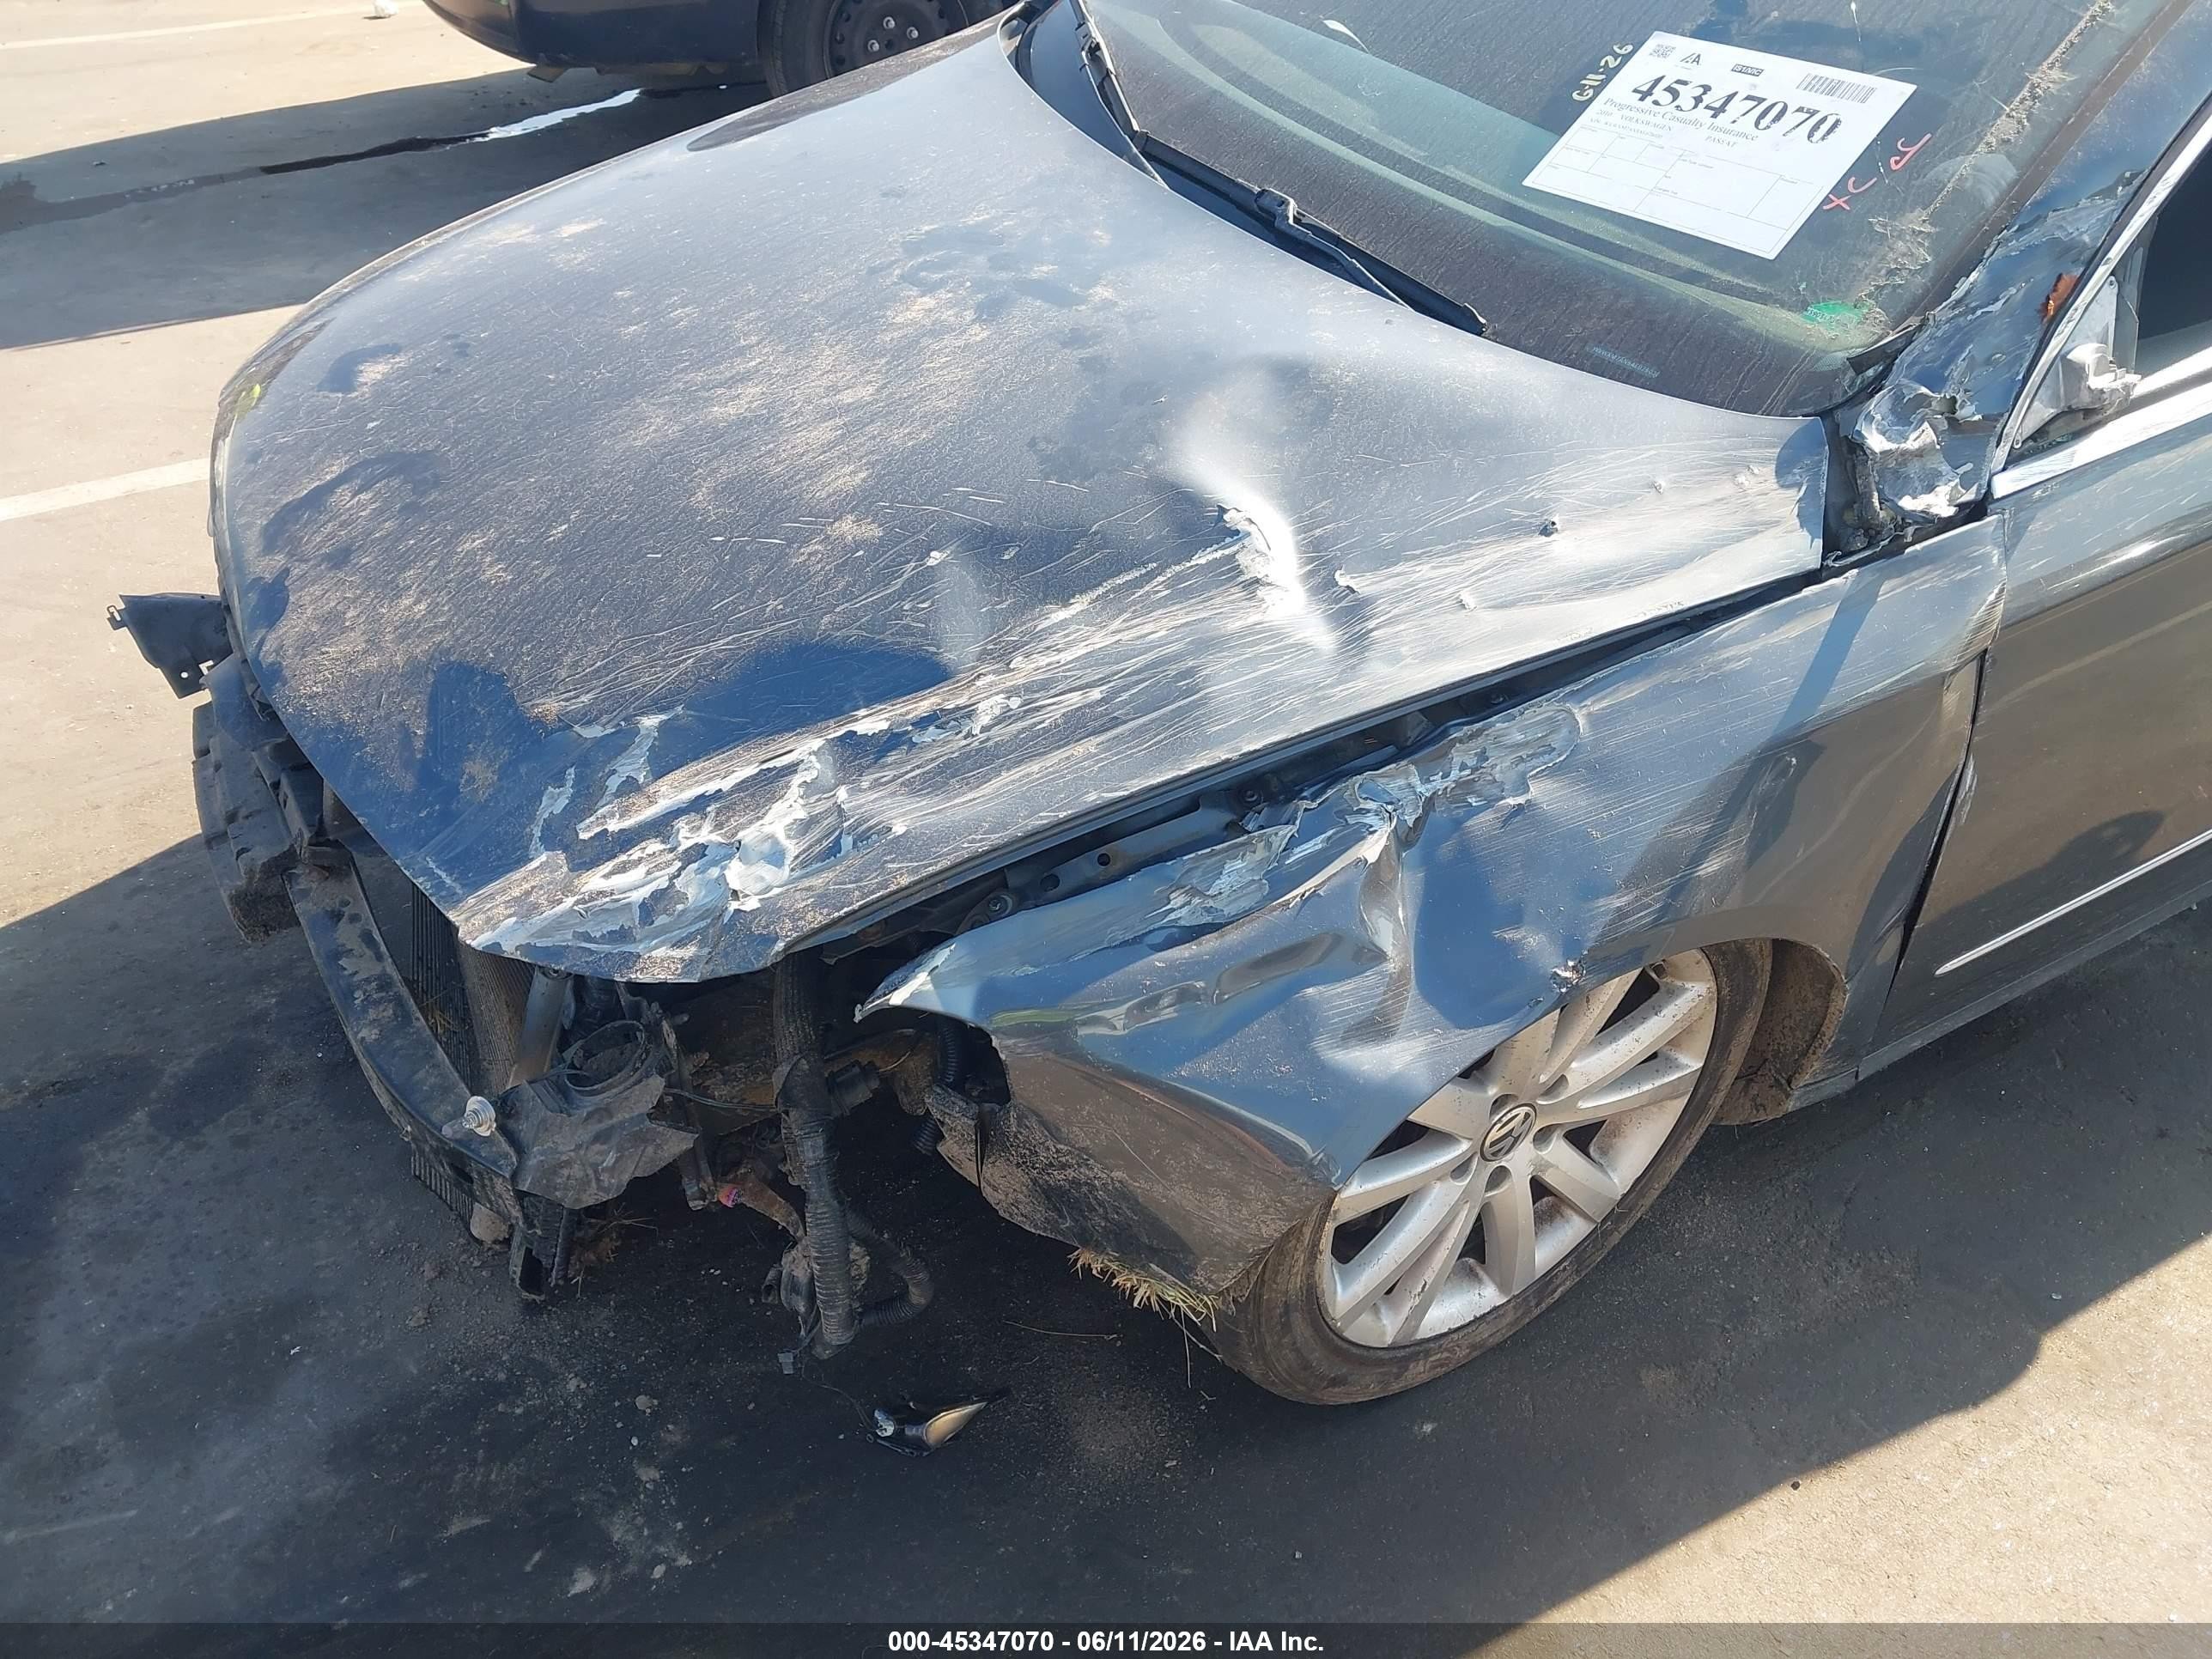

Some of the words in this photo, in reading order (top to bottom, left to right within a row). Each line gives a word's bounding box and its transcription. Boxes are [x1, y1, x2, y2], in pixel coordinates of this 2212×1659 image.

[1603, 97, 1661, 118] Progressive
[1662, 111, 1706, 130] Casualty
[1707, 122, 1759, 142] Insurance
[1620, 114, 1673, 131] VOLKSWAGEN
[1632, 75, 1843, 144] 45347070
